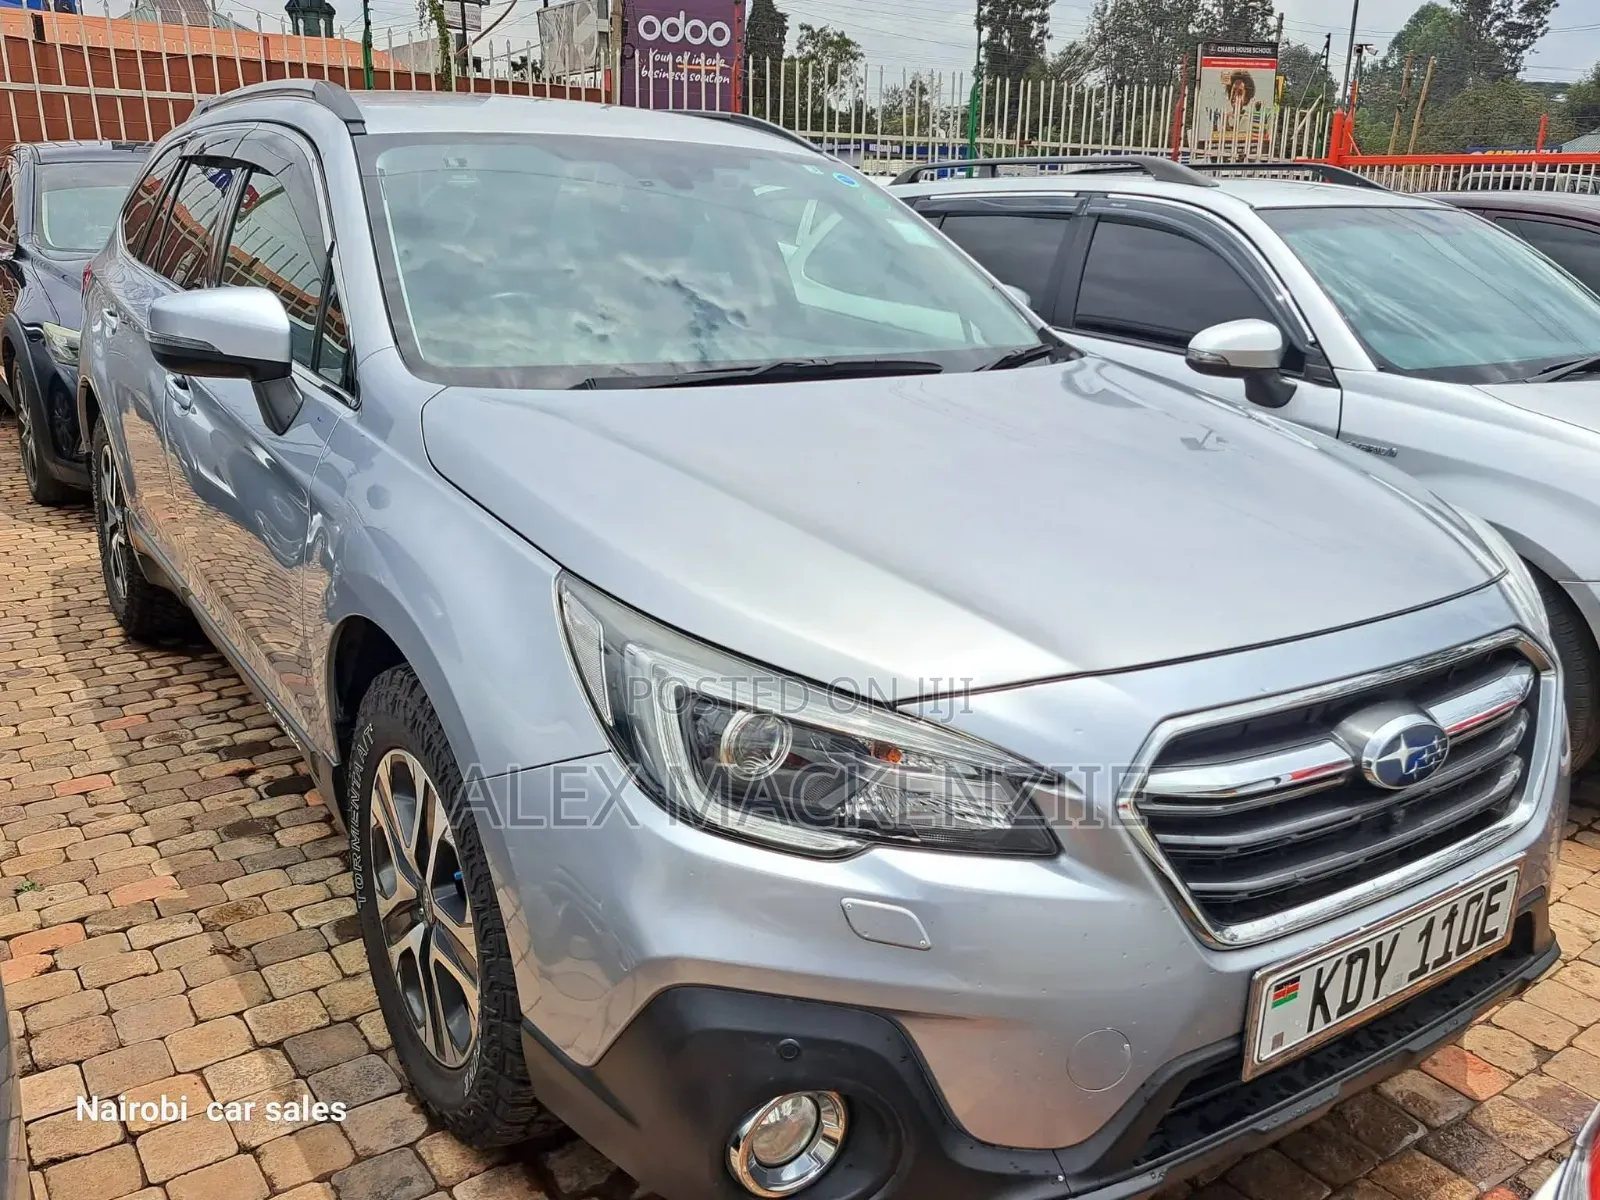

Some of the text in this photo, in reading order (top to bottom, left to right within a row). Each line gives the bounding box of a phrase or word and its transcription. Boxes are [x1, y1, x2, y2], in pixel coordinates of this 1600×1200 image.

[638, 10, 731, 47] odoo
[689, 72, 730, 84] souton
[350, 761, 367, 910] TORMENTA
[1307, 879, 1509, 1033] KDY 110E
